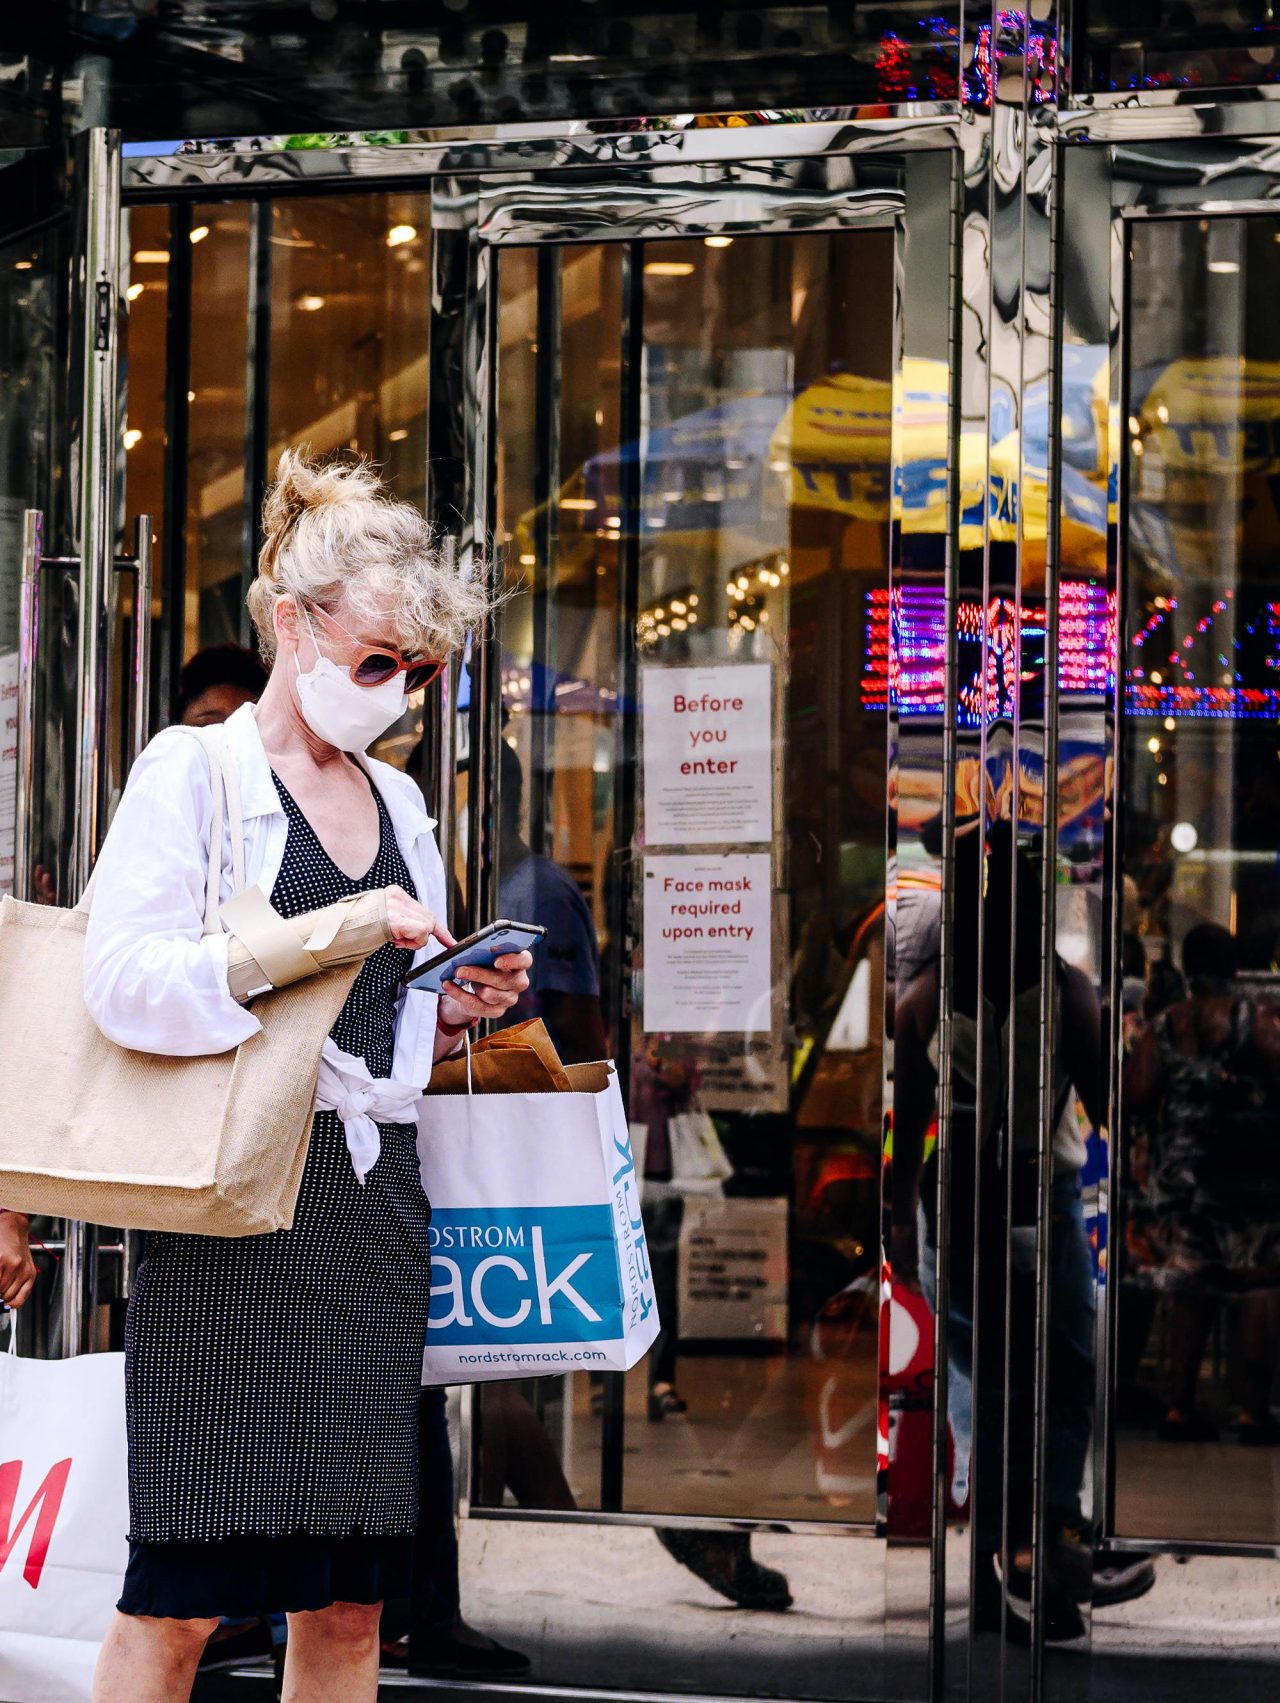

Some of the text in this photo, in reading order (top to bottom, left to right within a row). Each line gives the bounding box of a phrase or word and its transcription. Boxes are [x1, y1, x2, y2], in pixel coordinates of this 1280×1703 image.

[673, 694, 744, 713] Before
[688, 729, 728, 748] you
[679, 757, 737, 775] enter
[663, 877, 752, 893] Face mask
[671, 899, 742, 918] required
[662, 924, 754, 942] upon entry
[615, 1189, 640, 1329] NORDSTROM
[459, 1350, 607, 1364] nordstromrack.com
